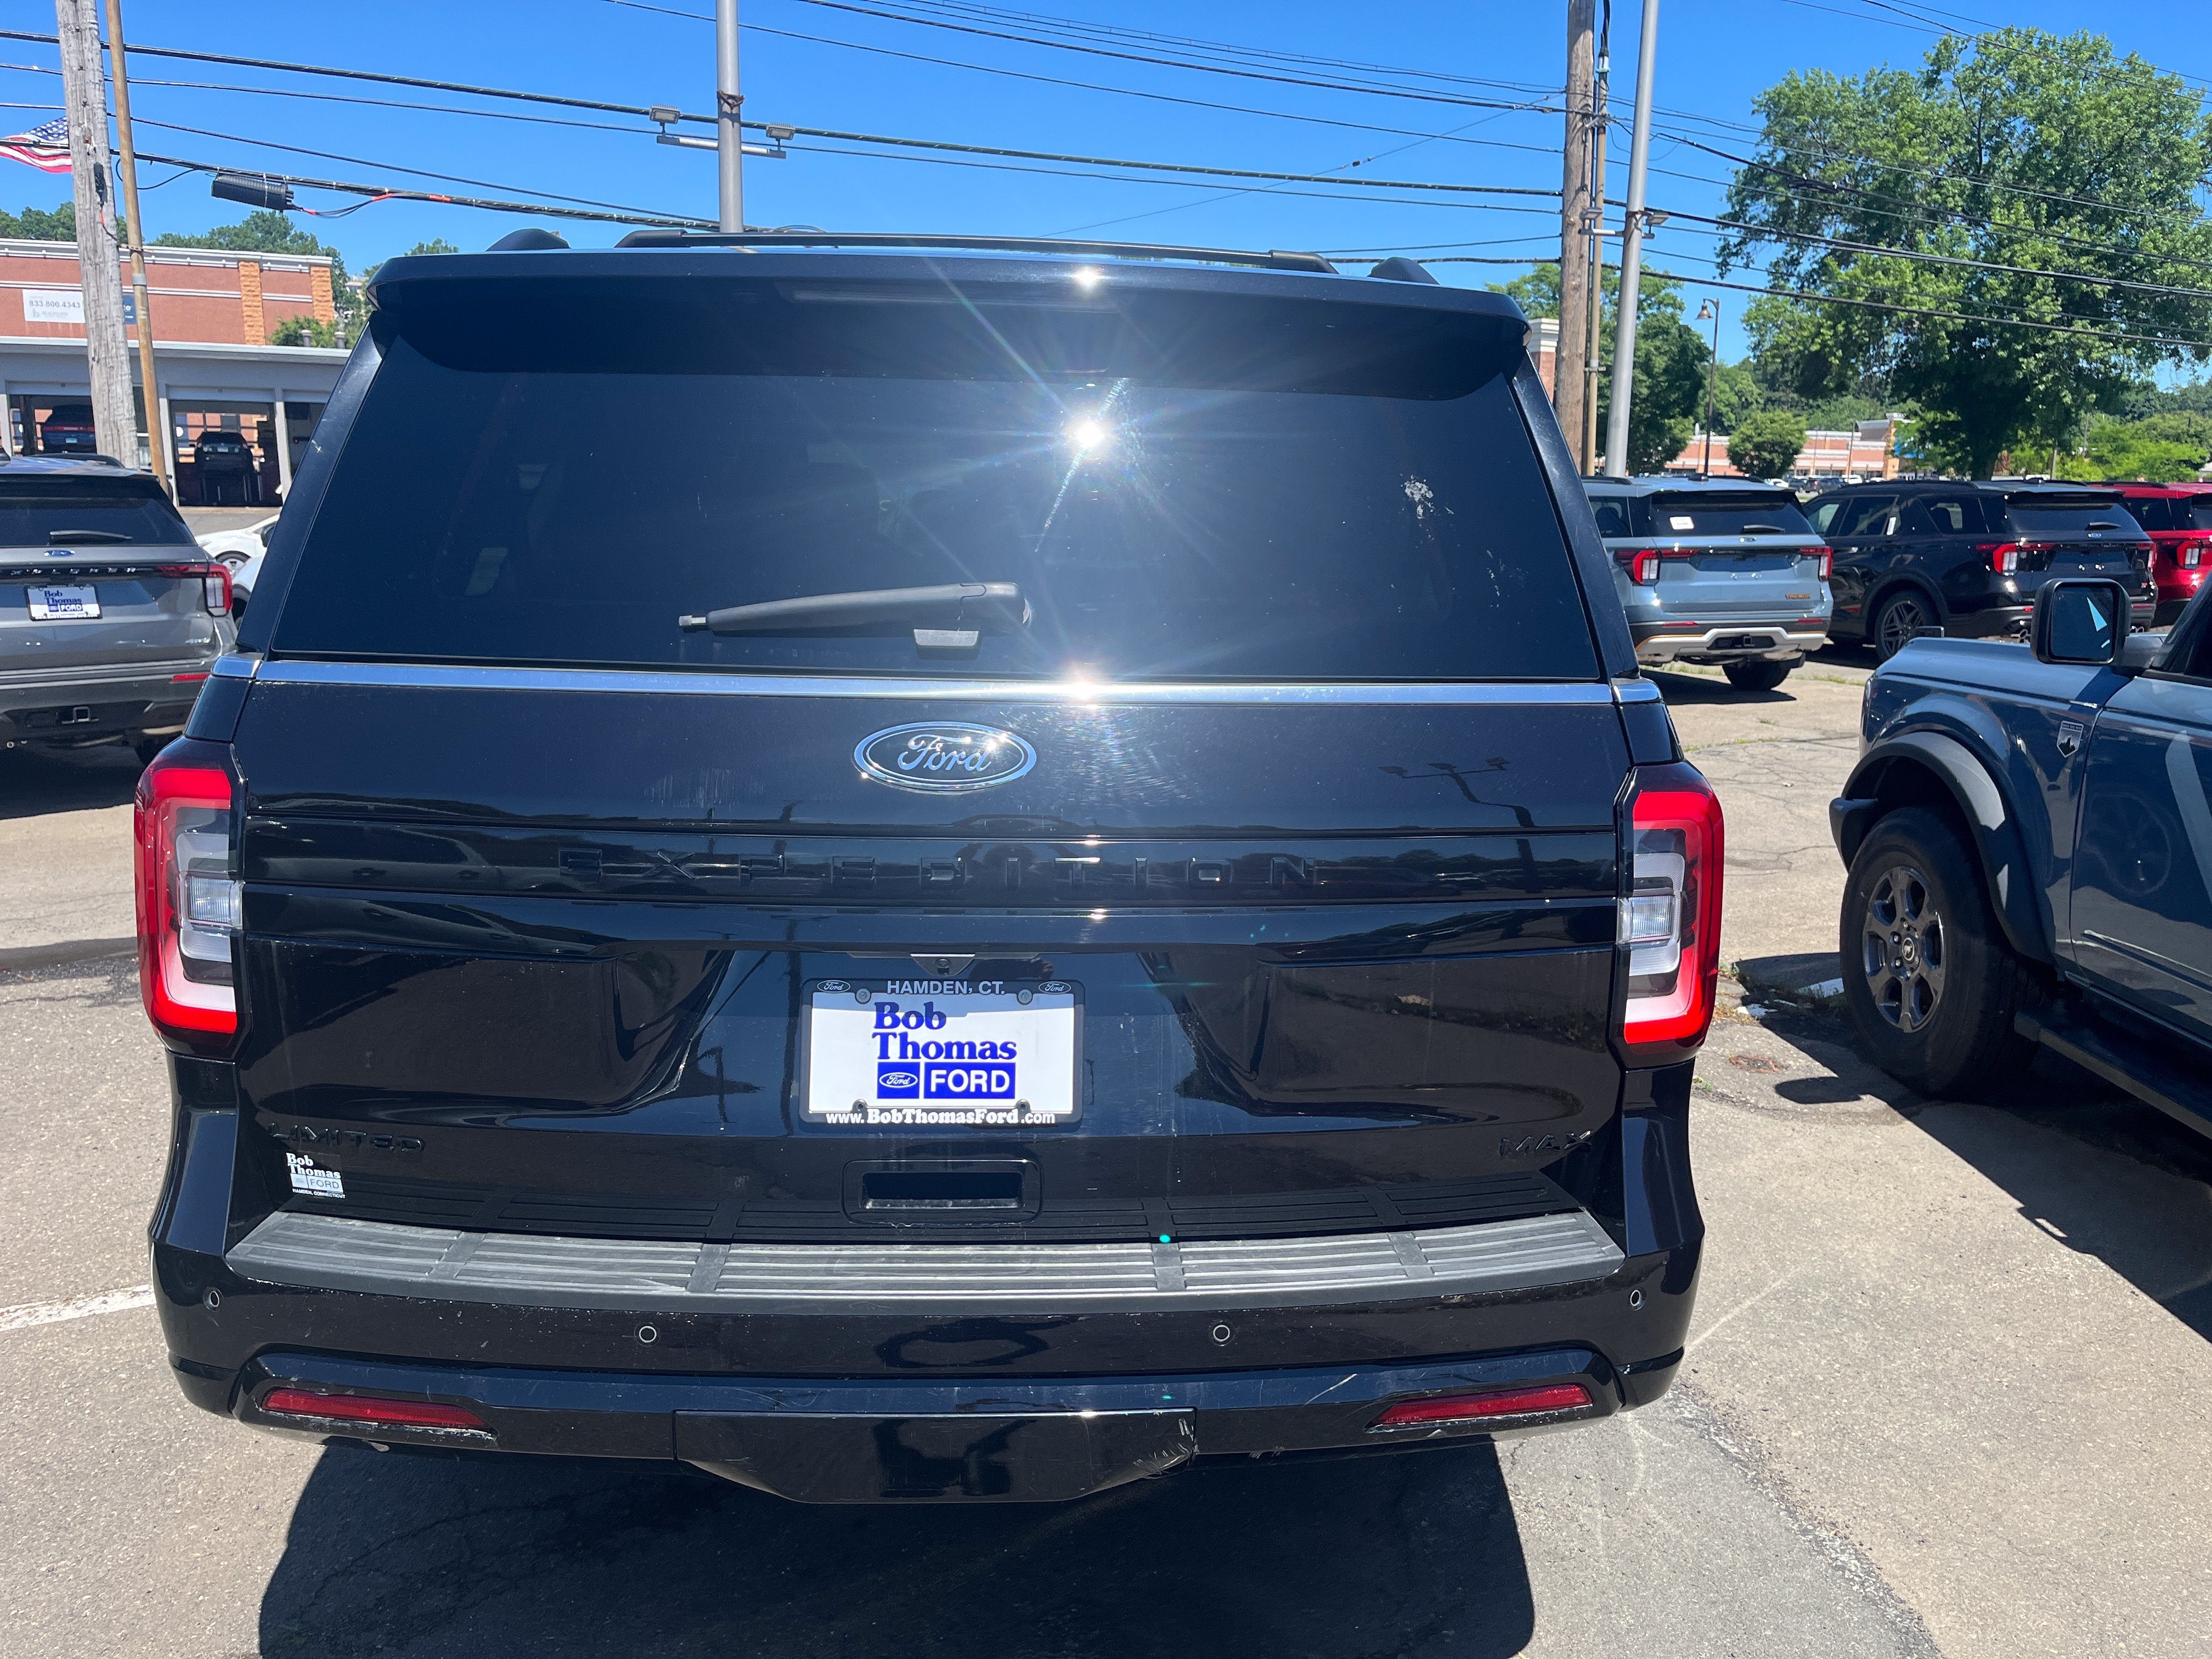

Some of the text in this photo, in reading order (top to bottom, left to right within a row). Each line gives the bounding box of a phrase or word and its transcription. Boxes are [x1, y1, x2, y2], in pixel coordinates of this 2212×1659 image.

[29, 300, 81, 308] 833.800.4343
[44, 596, 82, 605] Thomas
[898, 734, 991, 771] Ford
[558, 848, 1316, 889] EXPEDITION
[822, 981, 845, 992] Ford
[887, 980, 1005, 995] HAMDEN, CT.
[1043, 982, 1066, 992] Ford
[873, 1001, 947, 1030] Bob
[872, 1031, 1017, 1060] Thomas
[884, 1070, 1009, 1093] Ford FORD
[826, 1109, 1055, 1125] www.BobThomasFord.com
[268, 1122, 427, 1152] LIMITED
[1499, 1128, 1593, 1156] MAX
[286, 1153, 313, 1166] Bob
[287, 1163, 341, 1179] Thomas
[310, 1179, 339, 1189] FORD
